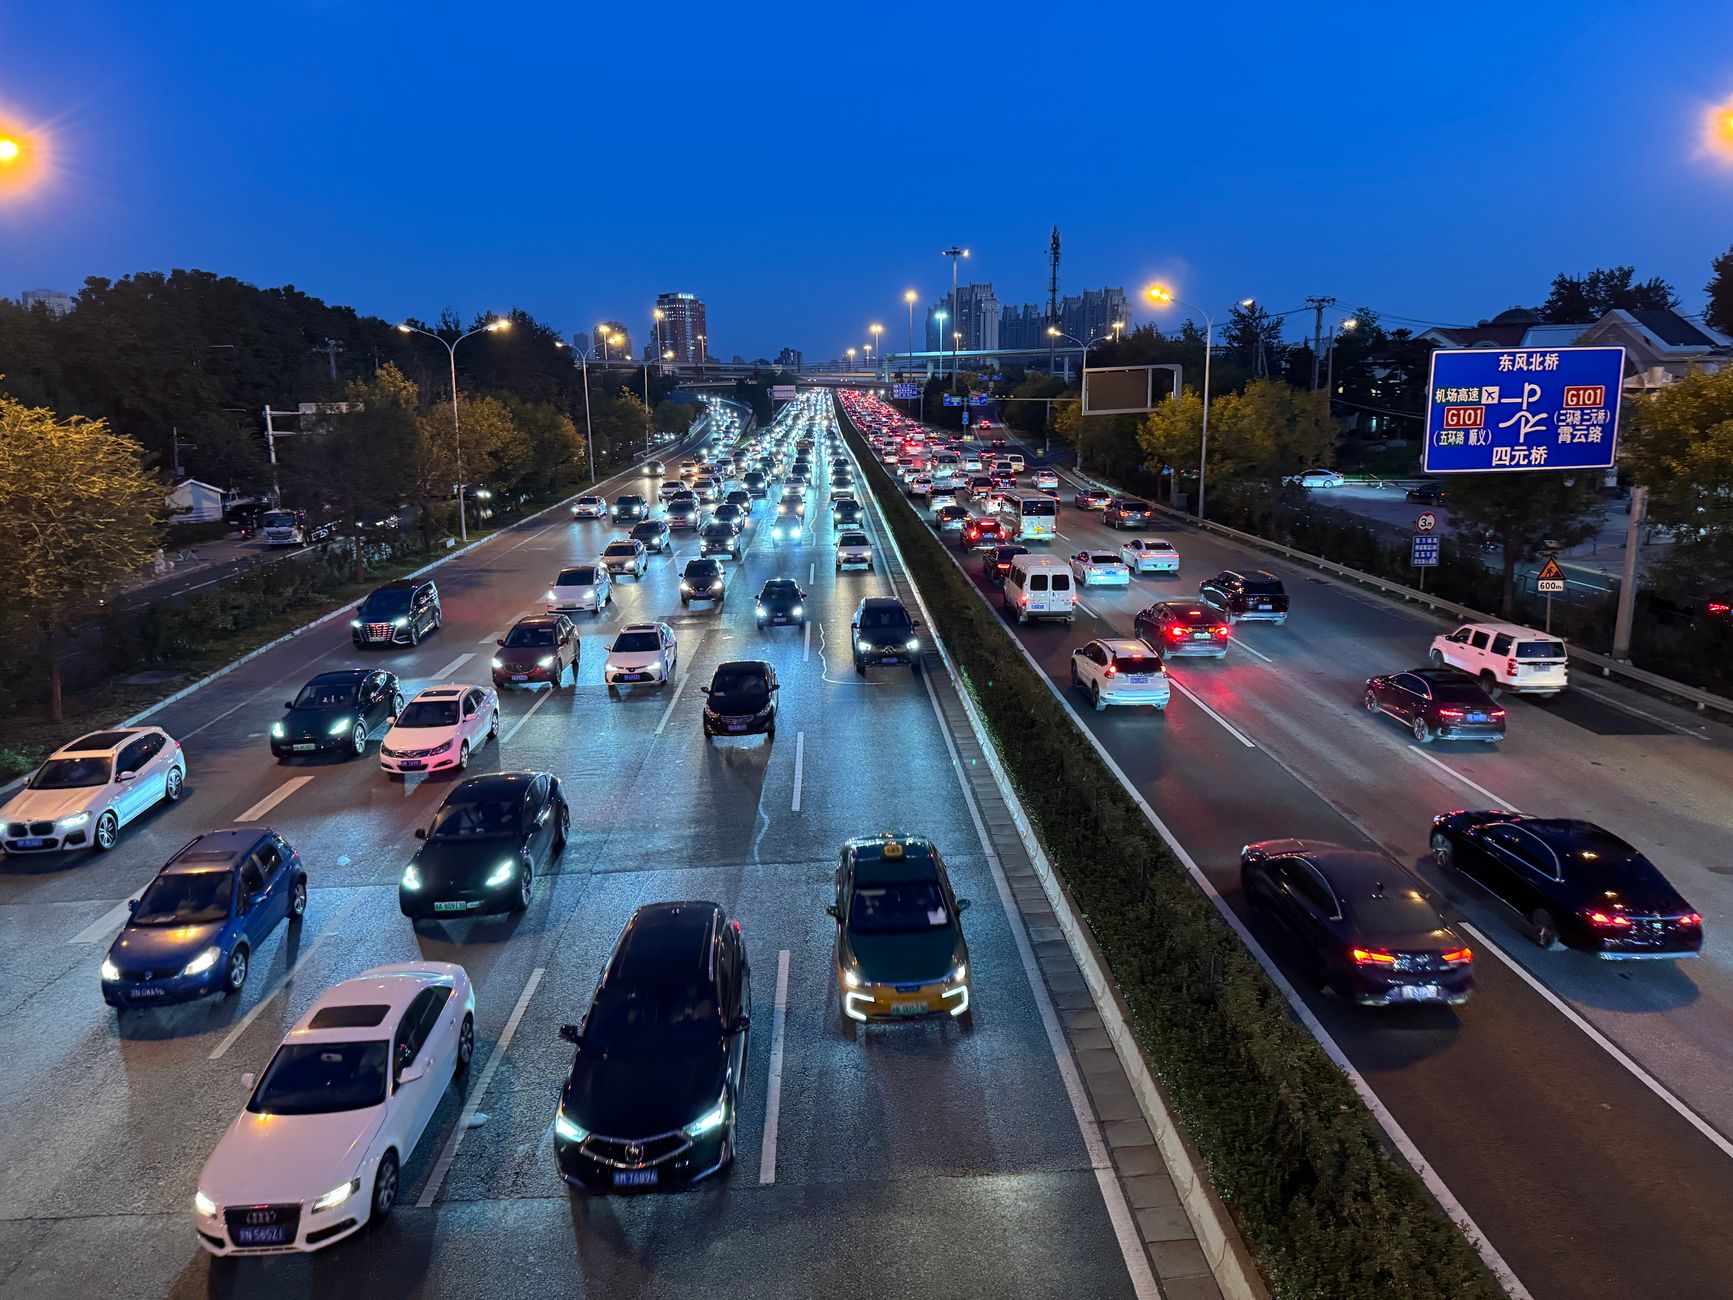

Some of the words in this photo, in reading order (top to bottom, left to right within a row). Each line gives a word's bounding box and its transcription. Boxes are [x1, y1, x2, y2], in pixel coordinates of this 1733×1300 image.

[1498, 353, 1560, 371] 东风北桥
[1435, 387, 1480, 403] 机场高速
[1567, 389, 1601, 405] G101
[1448, 409, 1482, 425] G101
[1557, 426, 1603, 444] 霄云路
[1492, 446, 1548, 466] 四元桥
[1540, 582, 1562, 590] 600m
